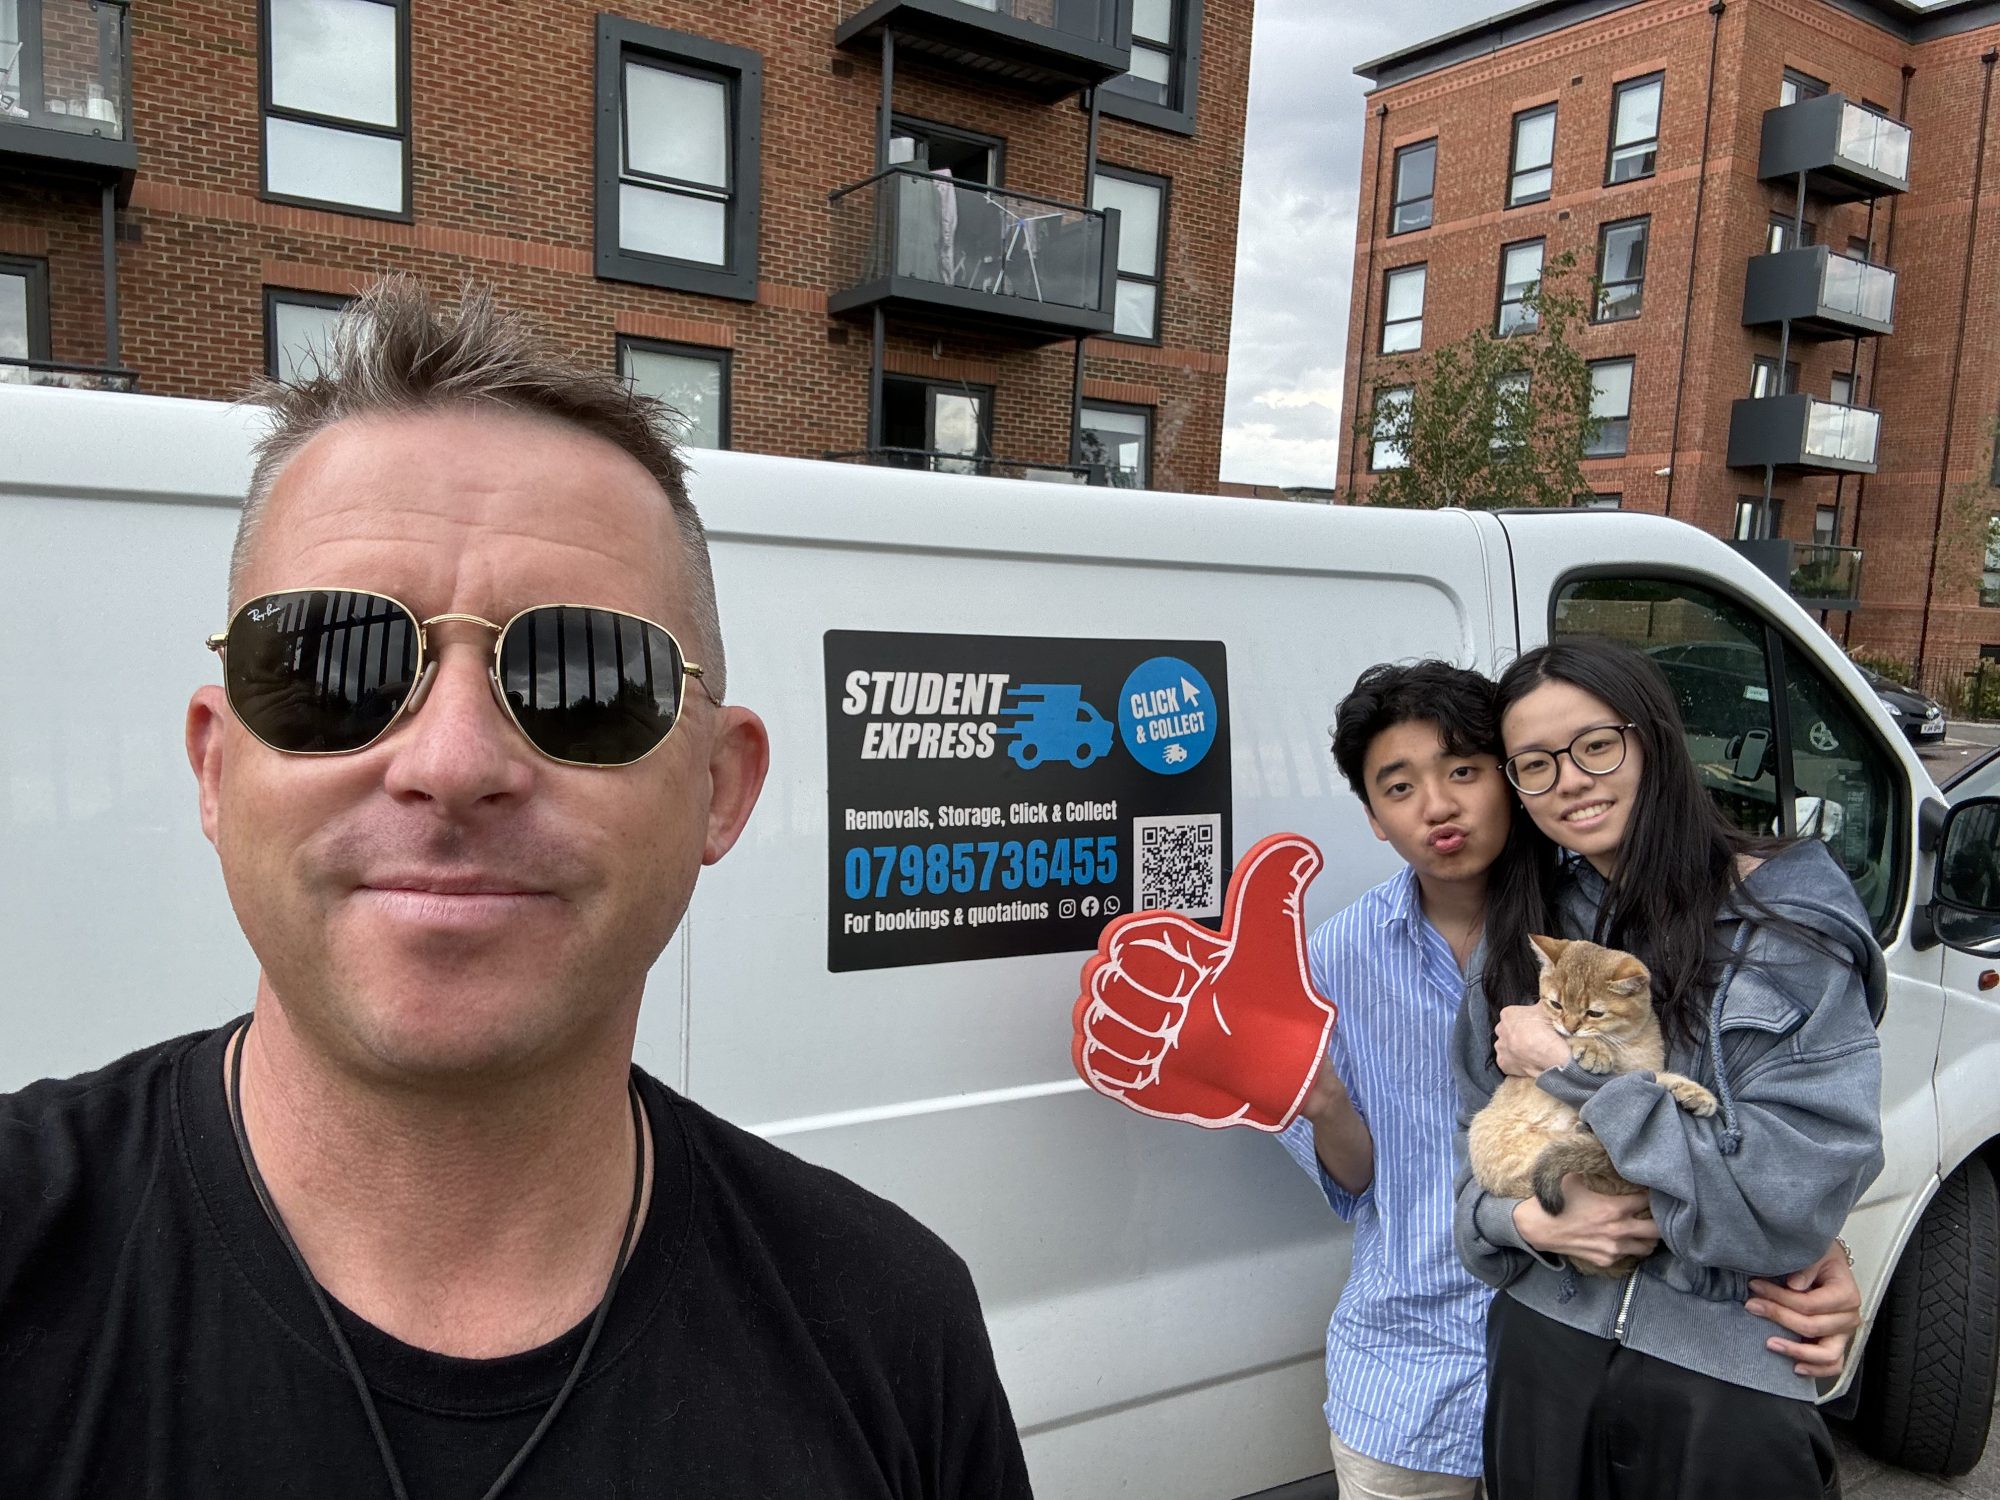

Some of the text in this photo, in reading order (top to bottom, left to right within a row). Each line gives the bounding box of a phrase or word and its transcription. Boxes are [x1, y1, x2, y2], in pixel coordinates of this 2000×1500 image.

[842, 670, 1010, 715] STUDENT
[1130, 687, 1180, 720] CLICK
[861, 722, 997, 759] EXPRESS
[1136, 711, 1205, 744] & COLLECT
[845, 800, 1117, 830] Removals, Storage, Click & Collect
[844, 836, 1118, 900] 07985736455
[844, 901, 1049, 934] For bookings & quotations
